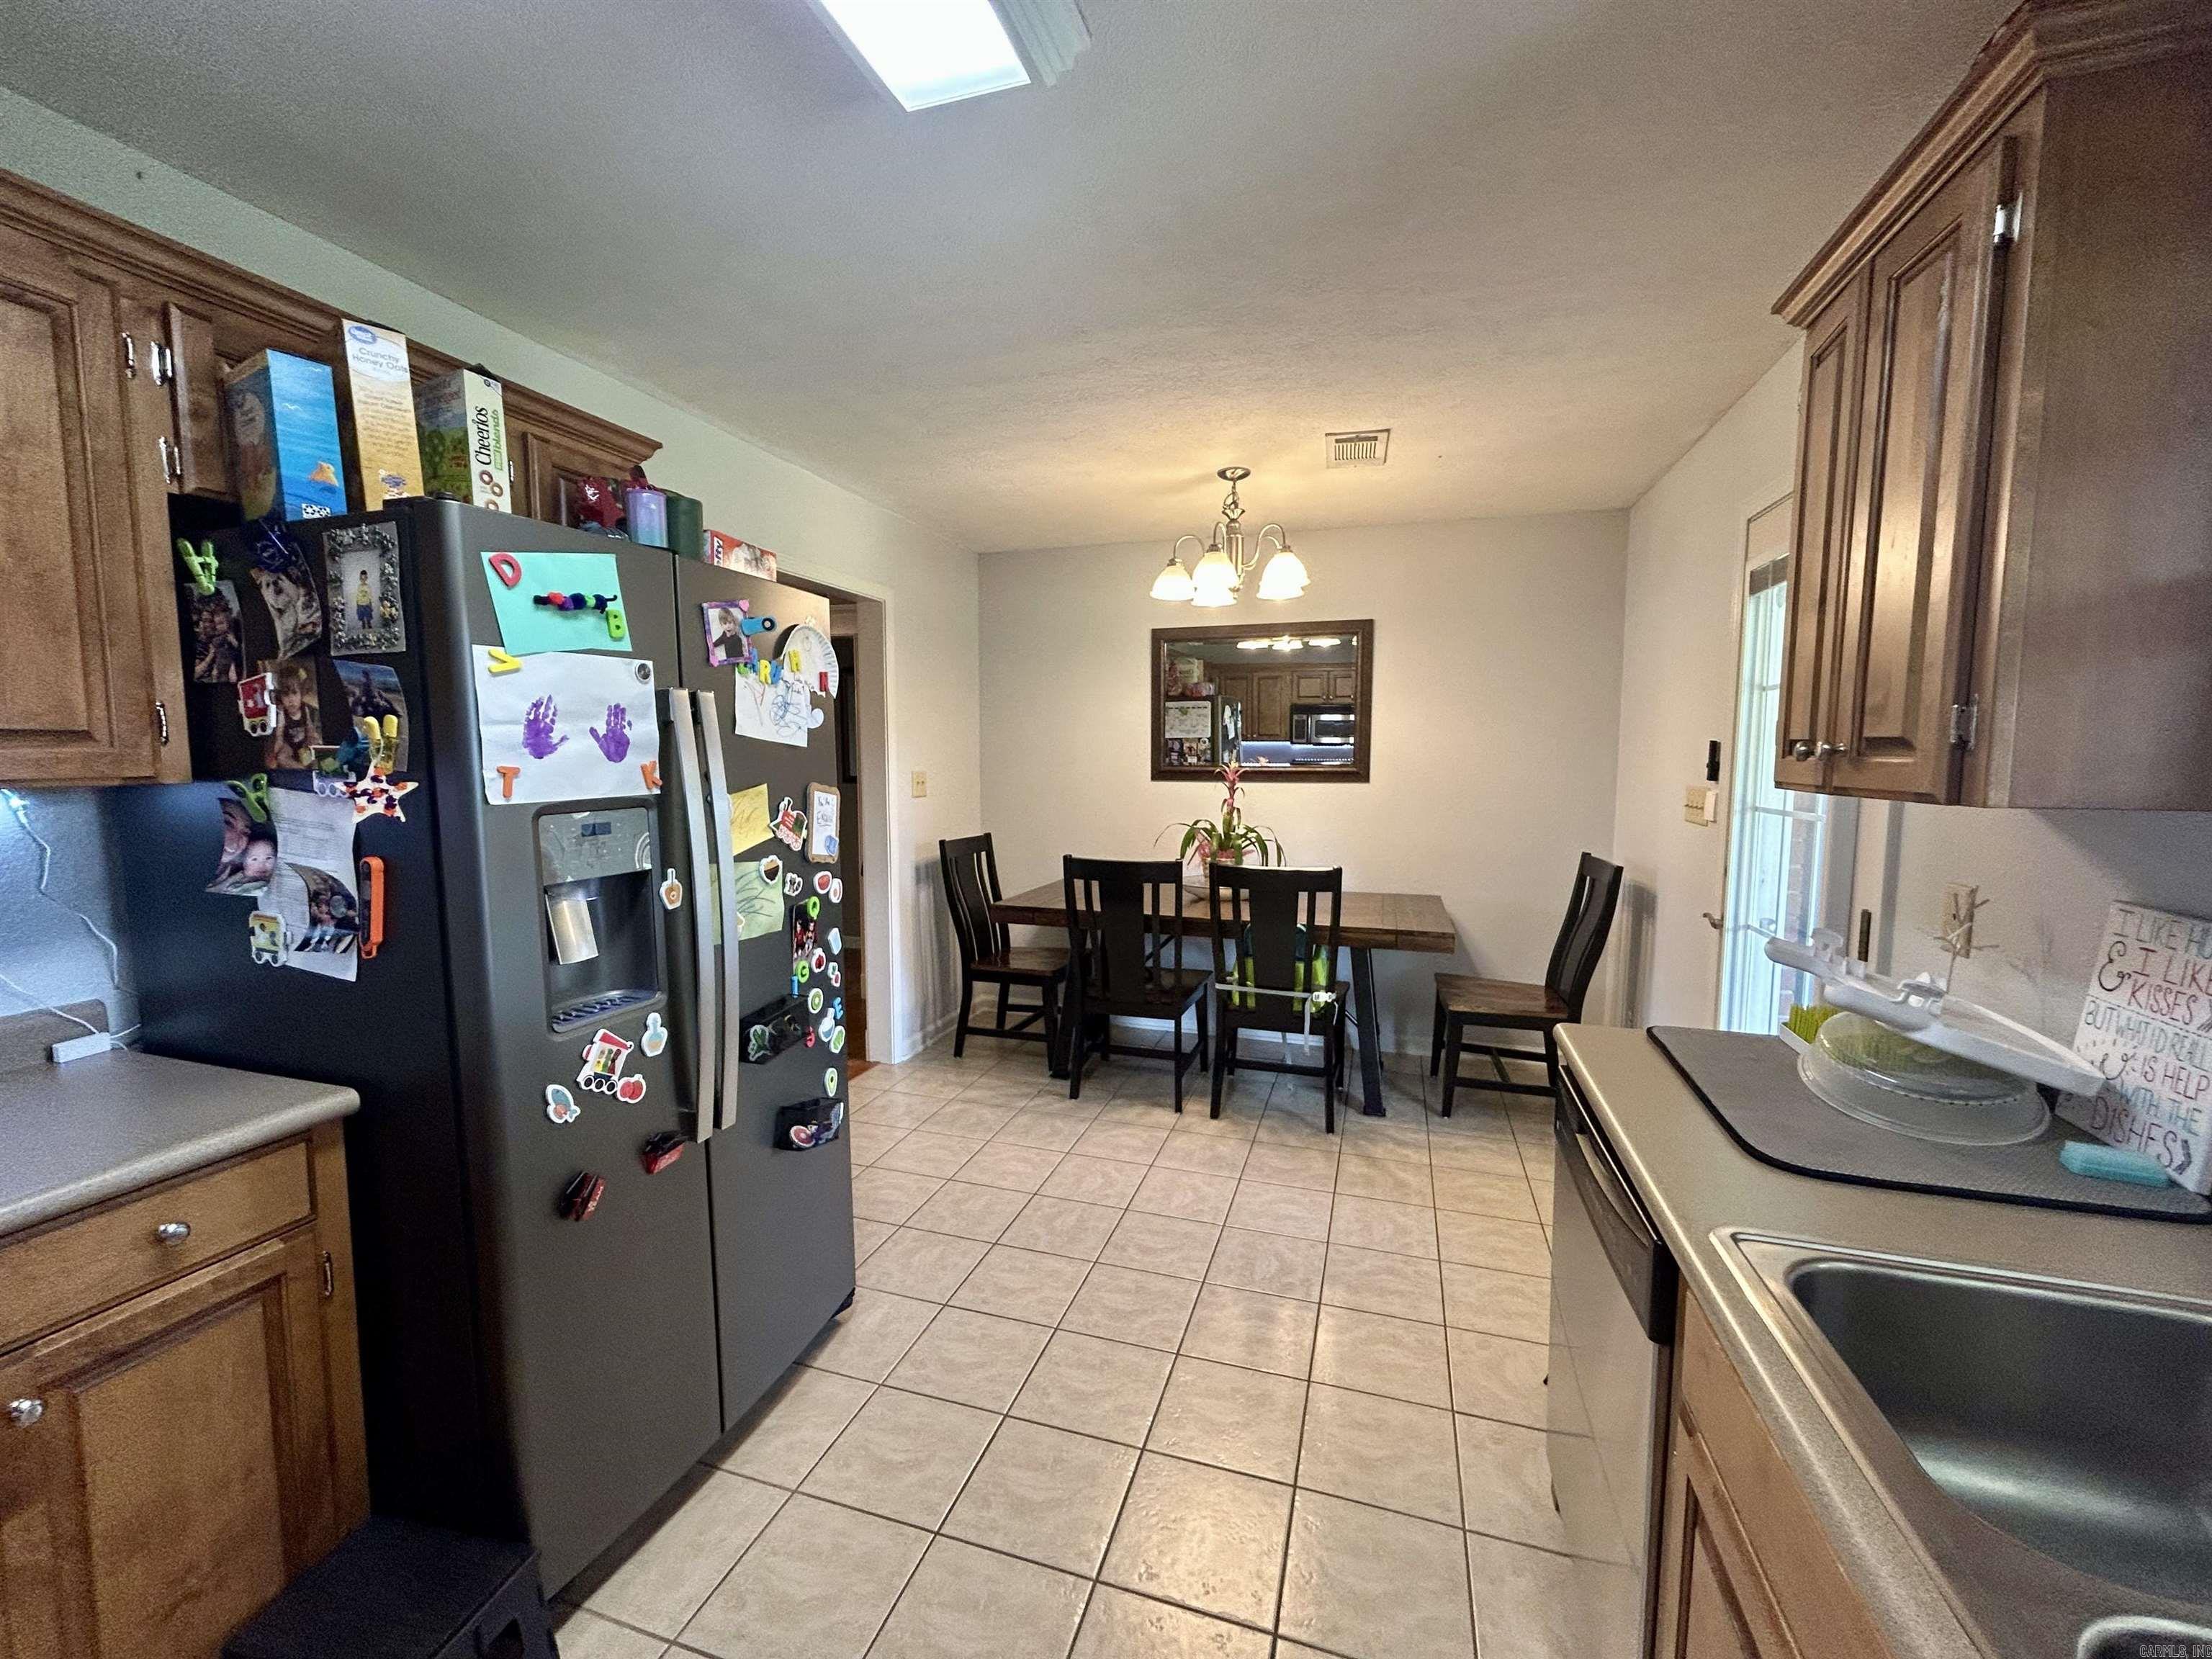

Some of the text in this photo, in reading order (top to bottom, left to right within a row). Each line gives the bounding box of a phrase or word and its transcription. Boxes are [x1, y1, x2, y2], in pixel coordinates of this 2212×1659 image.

[352, 354, 384, 368] Honey
[386, 361, 408, 373] Oats
[359, 347, 400, 364] Crunchy
[472, 406, 492, 465] Cheerios
[489, 552, 522, 588] D
[496, 765, 521, 800] T
[2113, 909, 2212, 960] I LIKE HU
[2098, 940, 2212, 997] & I LIKE
[2128, 979, 2199, 1025] KISSES
[2085, 1000, 2118, 1032] BUT
[2116, 1010, 2151, 1046] WHAT
[2170, 1033, 2212, 1072] REALL
[2141, 1056, 2158, 1082] IS
[2161, 1060, 2211, 1101] HELP
[2120, 1078, 2203, 1136] WITH THE
[2091, 1096, 2178, 1168] DISHES
